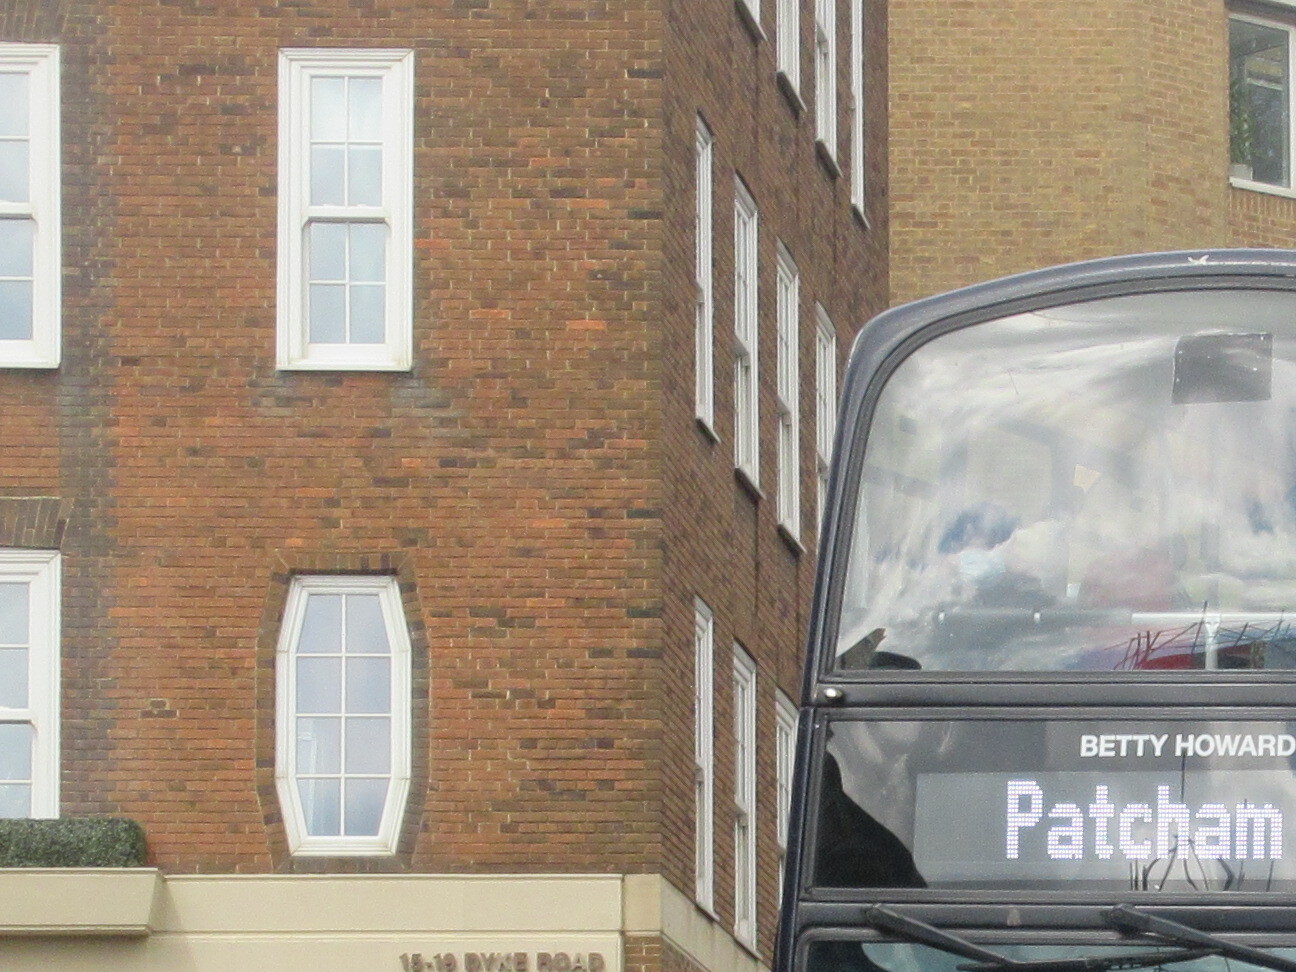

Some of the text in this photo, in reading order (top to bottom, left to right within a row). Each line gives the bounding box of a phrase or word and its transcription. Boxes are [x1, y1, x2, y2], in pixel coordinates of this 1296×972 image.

[1080, 734, 1296, 757] BETTY HOWARD
[1005, 780, 1283, 860] Patcham
